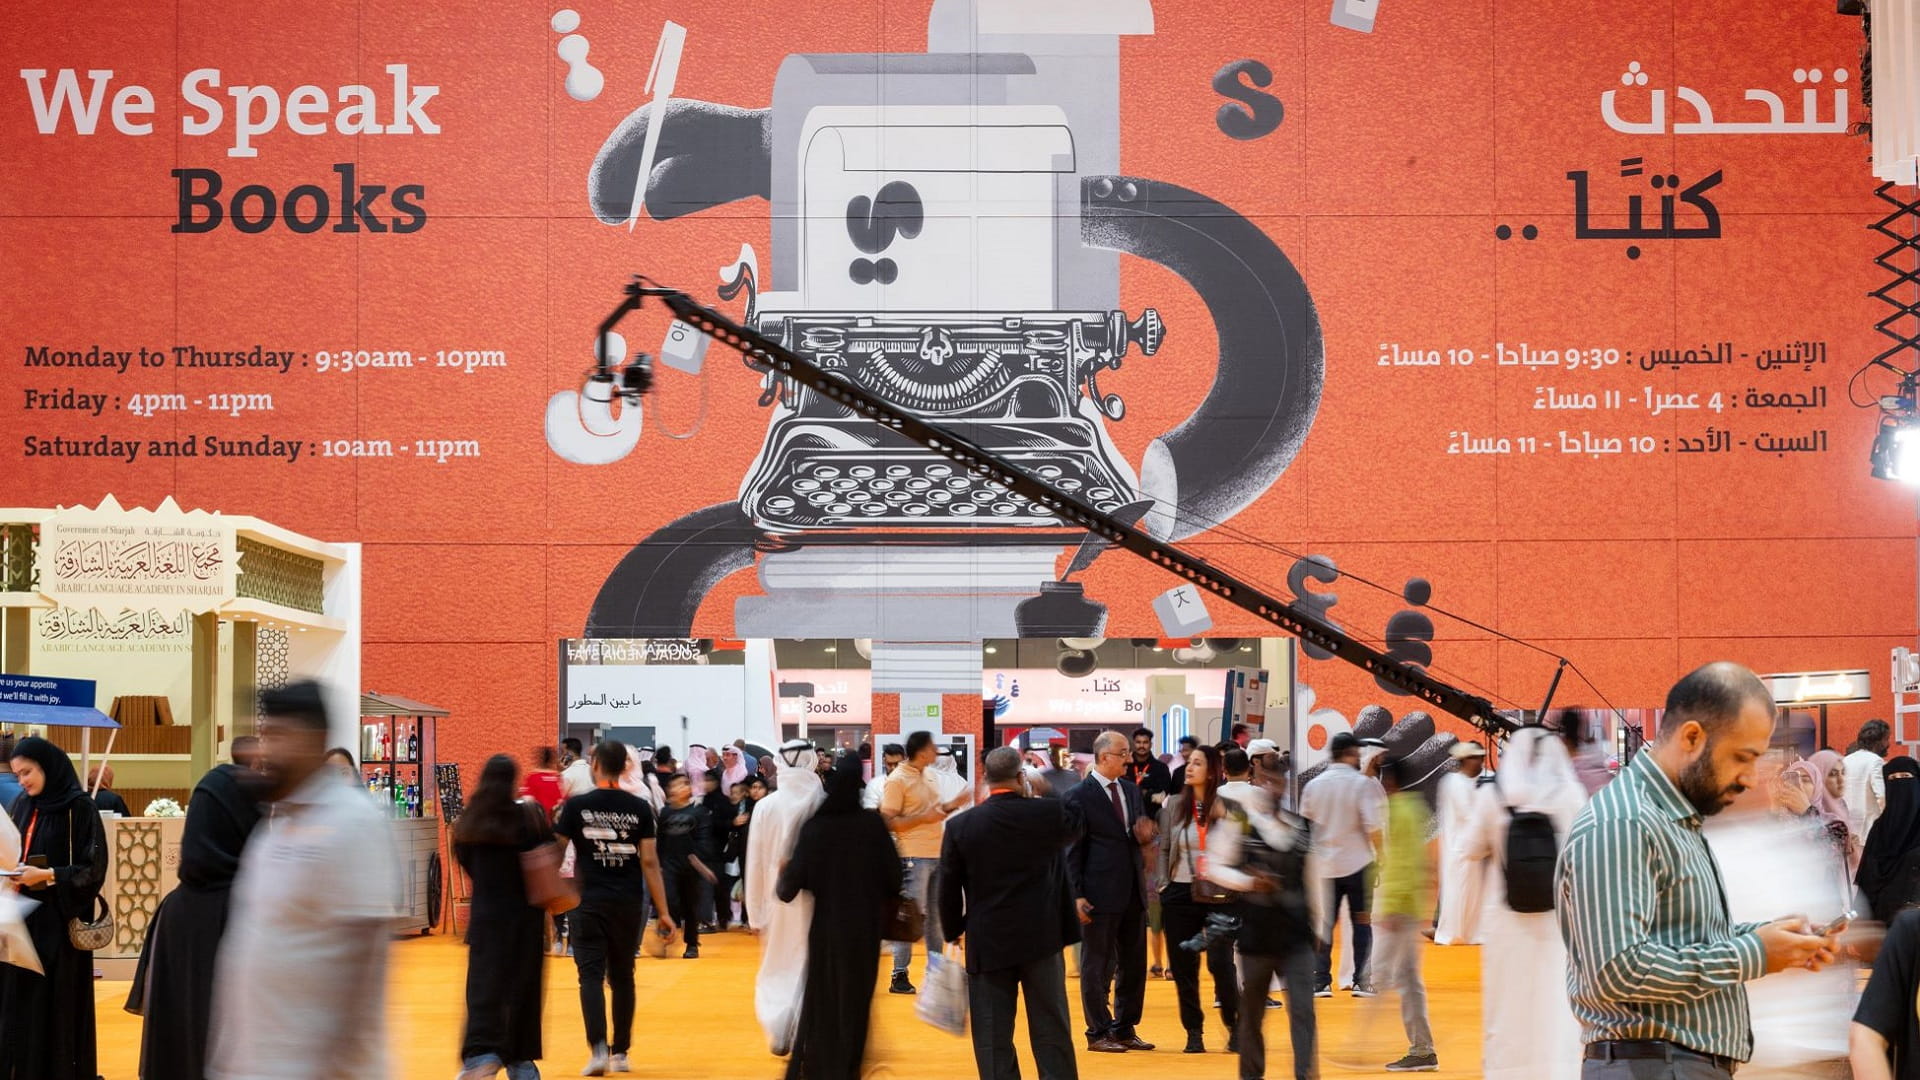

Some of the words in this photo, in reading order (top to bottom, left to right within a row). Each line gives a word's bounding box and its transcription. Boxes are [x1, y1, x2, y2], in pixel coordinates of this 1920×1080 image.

[1600, 61, 1849, 135] نتحدث
[20, 68, 156, 136] We
[181, 63, 442, 158] Speak
[171, 162, 427, 234] Books
[1566, 157, 1723, 260] كتبًا
[23, 345, 132, 371] Monday
[138, 349, 166, 368] to
[171, 345, 295, 372] Thursday
[314, 349, 413, 372] 9:30am
[436, 349, 508, 373] 10pm
[1447, 348, 1475, 366] 10
[1564, 348, 1620, 370] 9:30
[1639, 342, 1732, 371] الخميس
[1756, 342, 1827, 371] الإثنين
[23, 388, 108, 413] Friday
[127, 393, 188, 417] 4pm
[208, 393, 274, 417] 11pm
[1604, 390, 1621, 409] 11
[1708, 391, 1724, 413] 4
[1745, 386, 1827, 414] الجمعة
[23, 435, 141, 461] Saturday
[148, 436, 198, 457] and
[204, 435, 303, 461] Sunday
[322, 439, 393, 457] 10am
[415, 439, 481, 463] 11pm
[1516, 437, 1536, 454] 11
[1629, 436, 1656, 454] 10
[1677, 427, 1731, 453] الأحد
[1754, 430, 1828, 458] السبت
[56, 524, 99, 535] Government
[101, 525, 109, 535] of
[110, 526, 135, 537] Sharjah
[55, 582, 87, 593] ARABIC
[88, 583, 134, 595] LANGUAGE
[135, 584, 176, 595] ACADEMY
[176, 584, 186, 595] IN
[187, 584, 223, 596] SHARJAH
[41, 644, 72, 653] ARABIC
[6, 679, 14, 687] us
[15, 680, 29, 689] your
[30, 681, 58, 690] appetite
[28, 693, 34, 701] it
[34, 694, 49, 703] with
[49, 695, 61, 705] joy.
[568, 692, 607, 710] السطور
[610, 697, 630, 709] بين
[632, 692, 642, 706] ما
